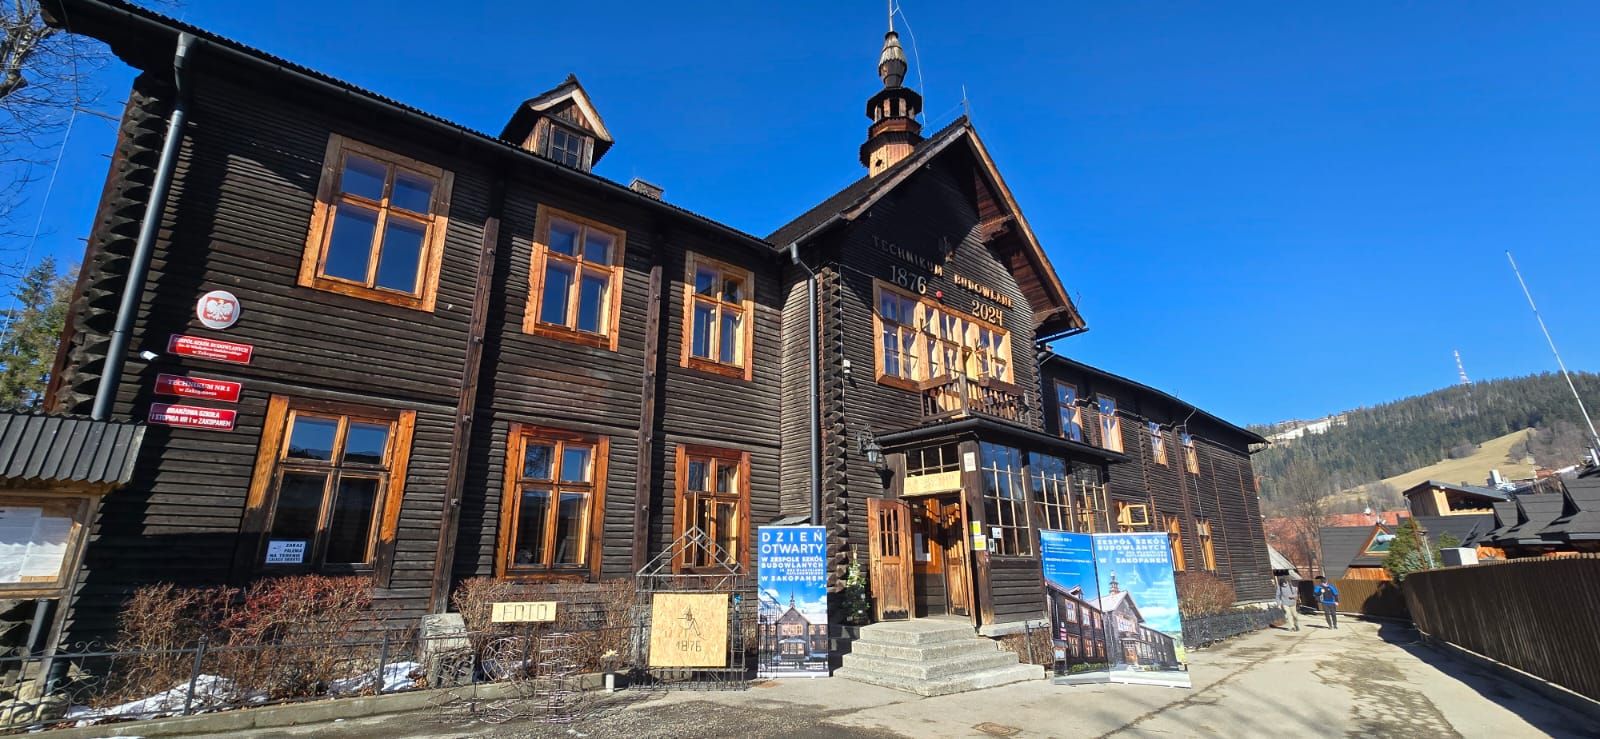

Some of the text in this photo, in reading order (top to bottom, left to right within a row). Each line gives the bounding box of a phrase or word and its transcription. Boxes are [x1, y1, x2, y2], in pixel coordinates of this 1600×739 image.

[872, 235, 1014, 308] TECHNIKUM BUDOWLANE
[891, 265, 1003, 326] 1876 2024
[168, 379, 214, 389] TECHNIKUM
[762, 529, 822, 542] DZIEŃ
[762, 544, 823, 554] OTWARTY
[503, 604, 547, 621] FOTO
[676, 640, 702, 652] 1876
